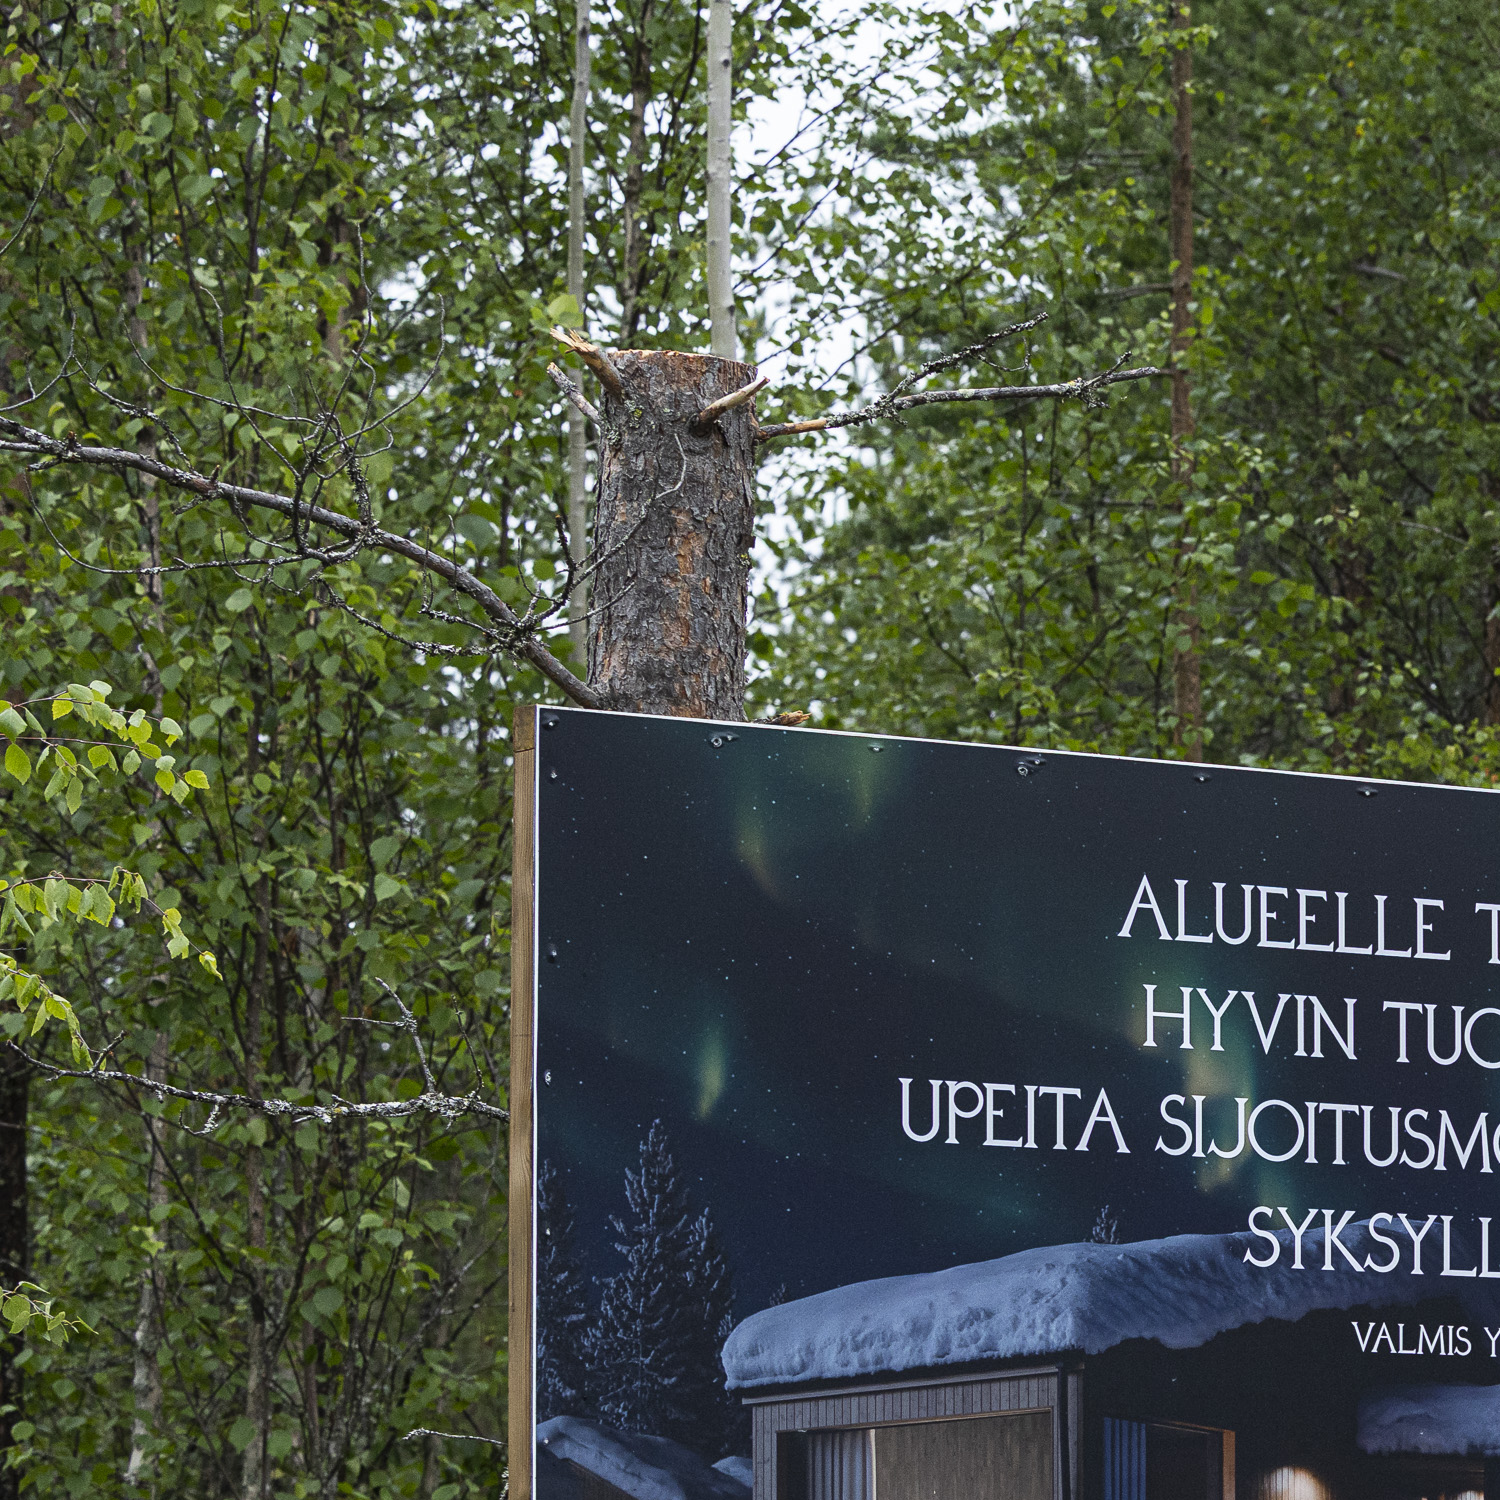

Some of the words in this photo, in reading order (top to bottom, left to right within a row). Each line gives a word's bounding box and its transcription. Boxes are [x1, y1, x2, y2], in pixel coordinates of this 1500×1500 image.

[1117, 874, 1451, 961] ALUEELLE
[1142, 983, 1358, 1060] HYVIN
[898, 1077, 1131, 1154] UPEITA
[1351, 1321, 1472, 1356] VALMIS
